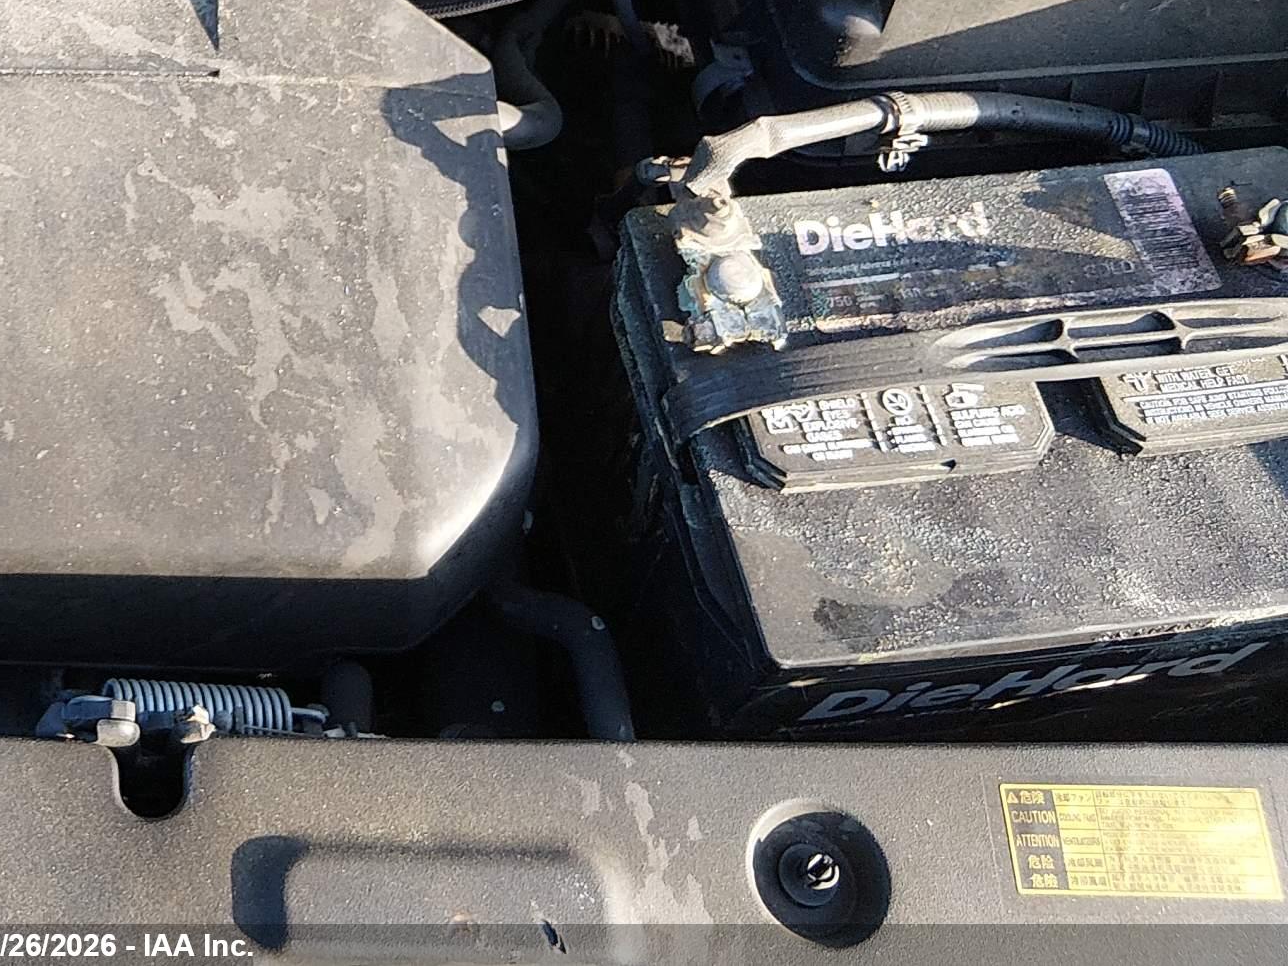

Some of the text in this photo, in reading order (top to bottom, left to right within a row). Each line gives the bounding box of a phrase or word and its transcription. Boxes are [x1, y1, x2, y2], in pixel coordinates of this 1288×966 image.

[794, 202, 991, 256] DieHard
[1154, 372, 1180, 383] WITH
[1215, 365, 1236, 376] GET
[1159, 382, 1200, 394] MEDICAL
[1201, 378, 1225, 390] HELP
[801, 641, 1270, 721] DieHard
[1012, 810, 1056, 824] CAUTION
[1016, 834, 1060, 848] ATTENTION
